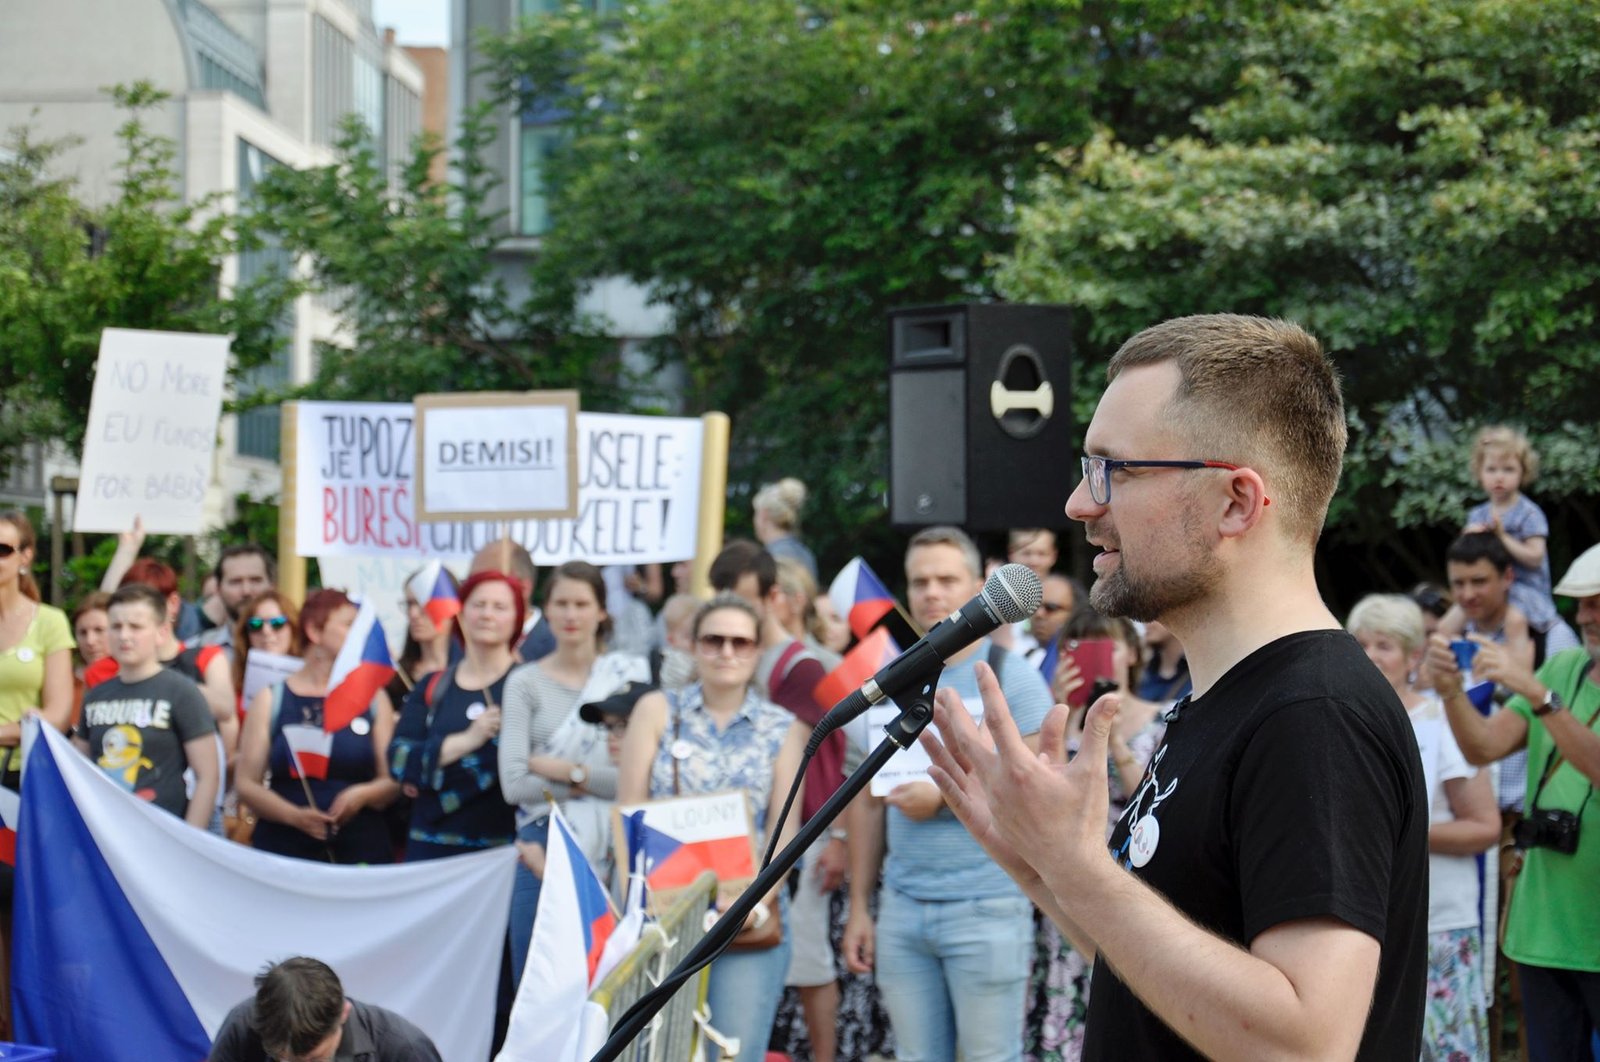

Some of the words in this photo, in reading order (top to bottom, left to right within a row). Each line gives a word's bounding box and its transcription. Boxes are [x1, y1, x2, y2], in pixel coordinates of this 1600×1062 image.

[110, 359, 149, 393] NO
[102, 411, 143, 443] EU
[322, 415, 355, 447] TU
[360, 416, 413, 480] POZ
[438, 437, 553, 465] DEMISI!
[322, 451, 352, 479] JE
[92, 473, 134, 499] FOR
